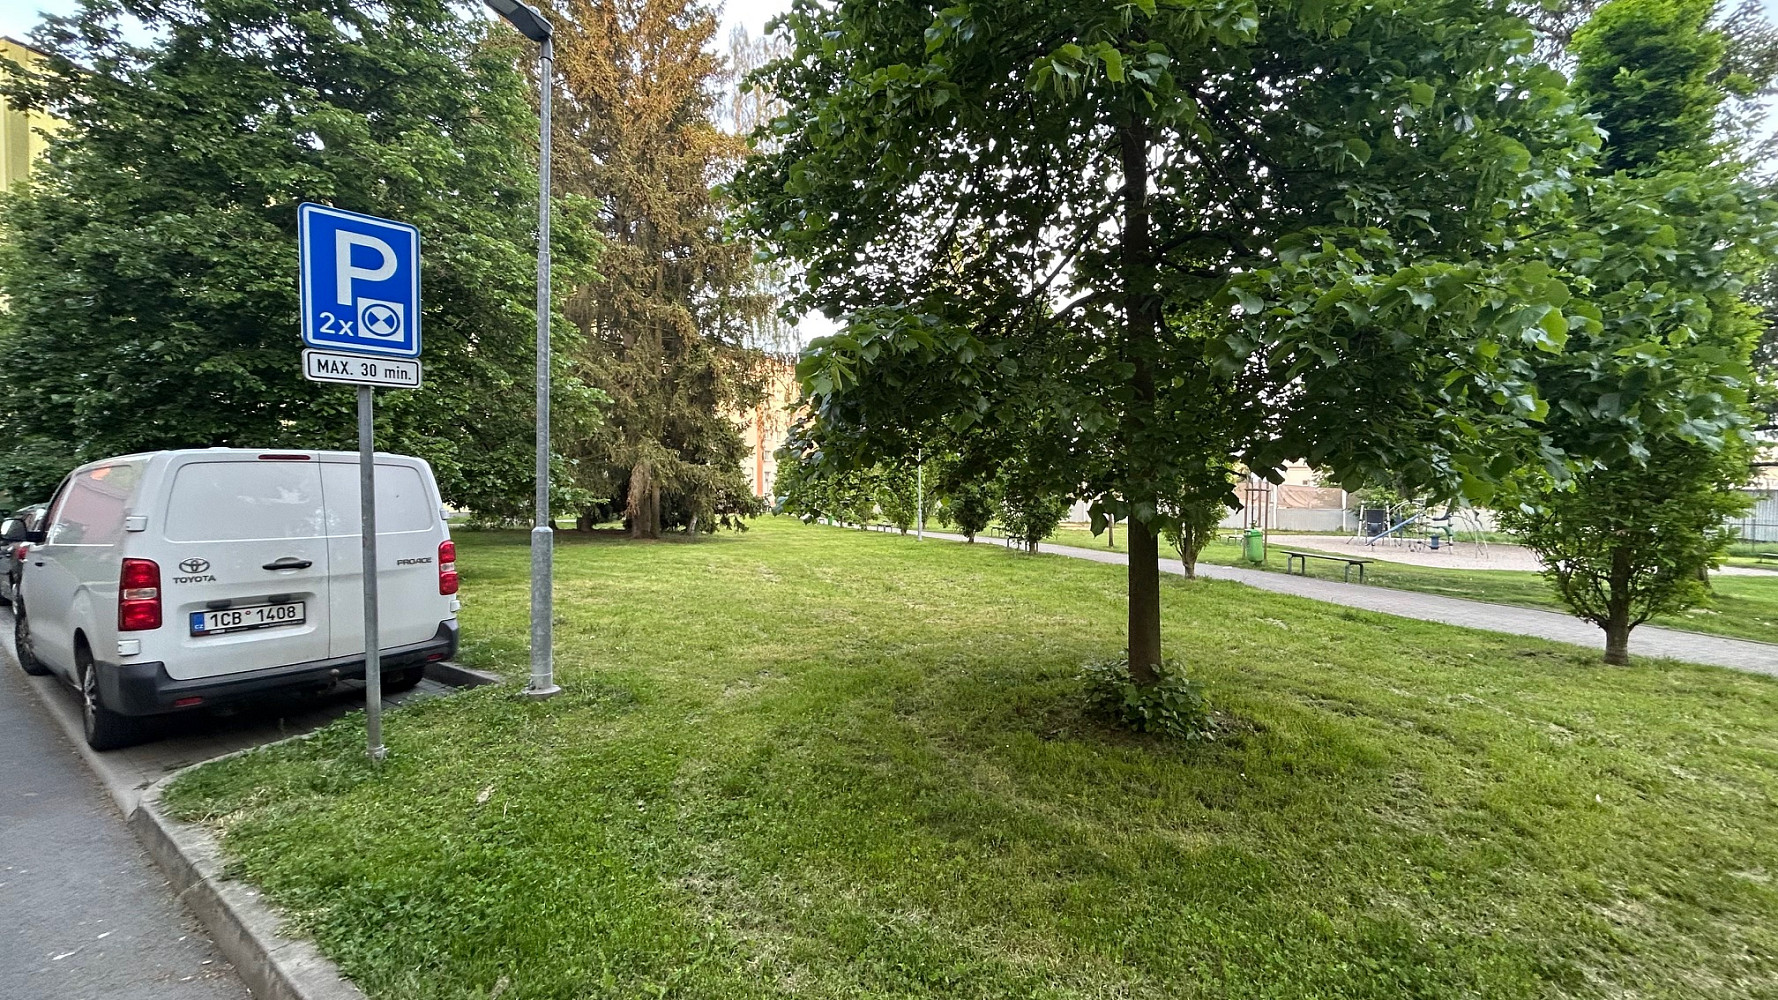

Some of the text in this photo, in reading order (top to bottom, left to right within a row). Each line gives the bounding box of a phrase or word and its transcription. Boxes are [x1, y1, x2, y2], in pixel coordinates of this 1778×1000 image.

[336, 229, 397, 306] P
[319, 312, 354, 337] 2x
[317, 359, 411, 380] MAX. 30 min.
[397, 557, 432, 566] PROACE
[172, 575, 216, 584] TOYOTA
[210, 612, 242, 627] 1CB
[256, 606, 296, 622] 1408
